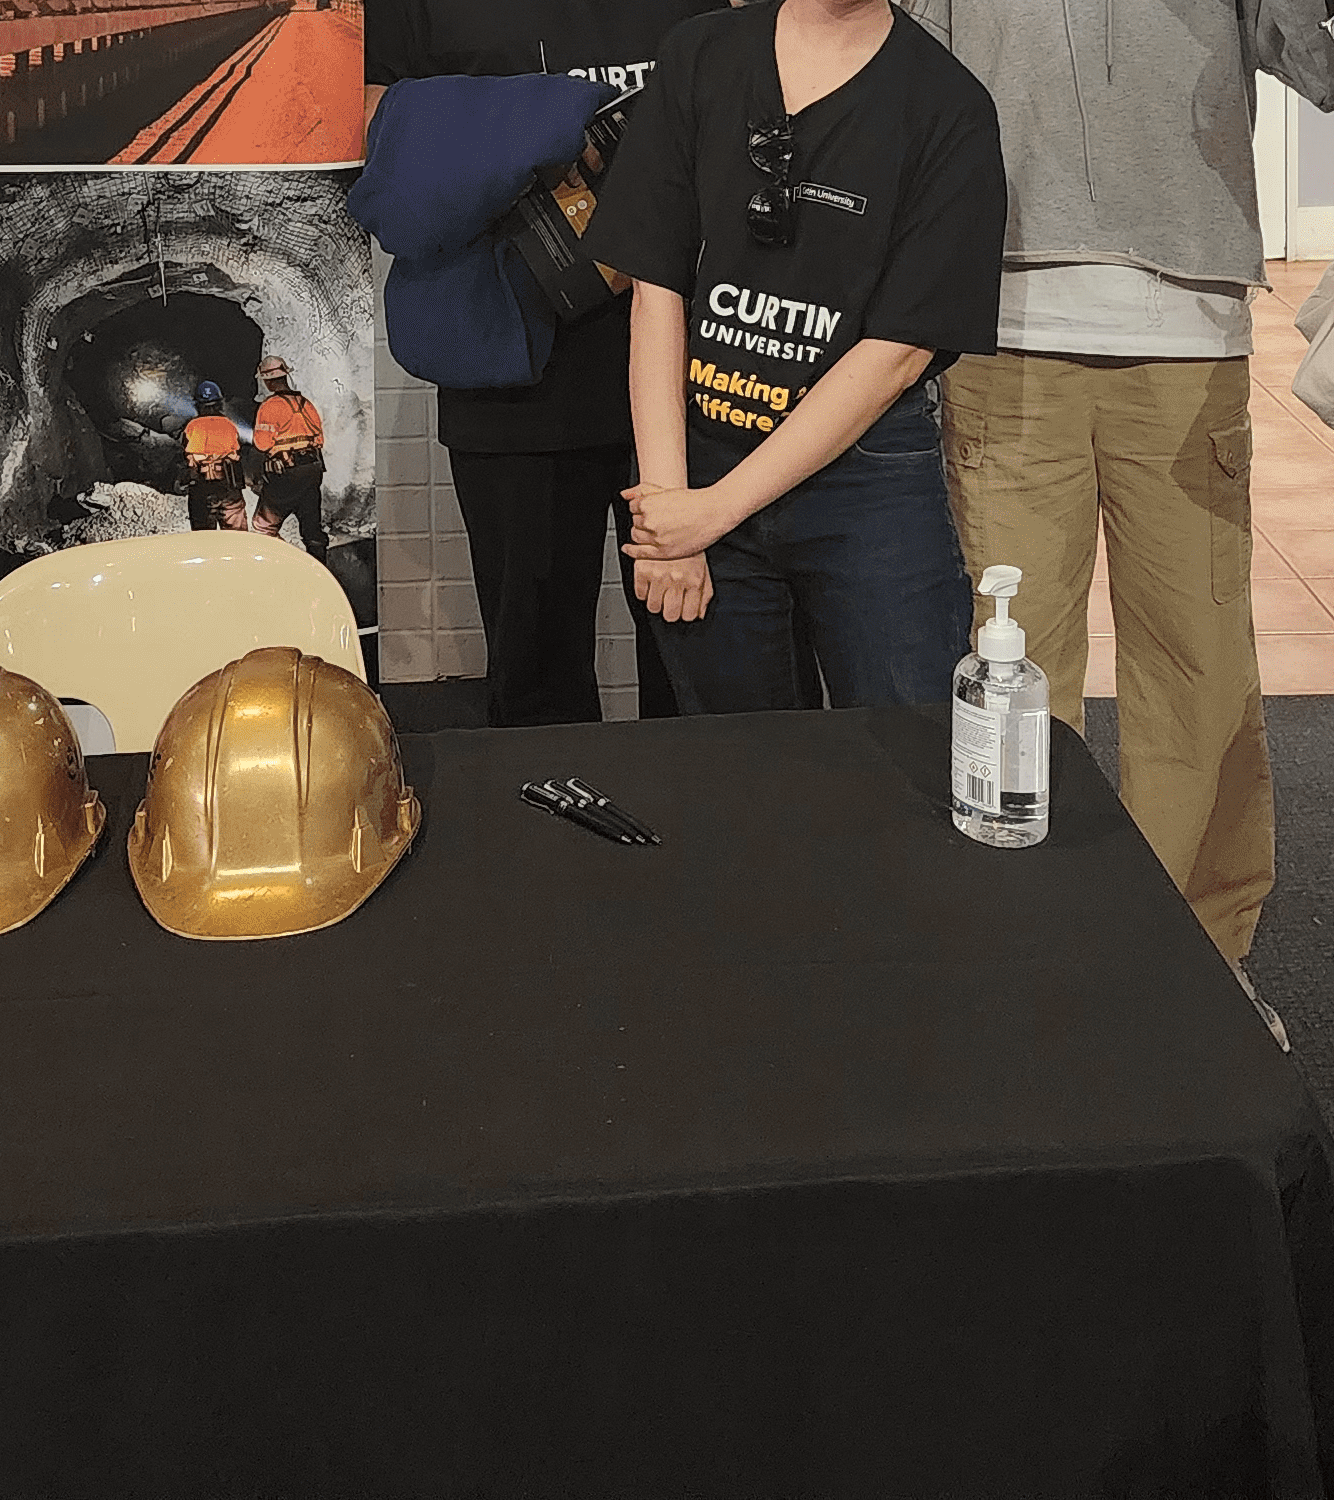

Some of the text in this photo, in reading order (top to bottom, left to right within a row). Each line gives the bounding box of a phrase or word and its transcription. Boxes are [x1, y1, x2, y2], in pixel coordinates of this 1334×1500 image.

[816, 188, 855, 208] University
[708, 283, 842, 343] CURTIN
[700, 319, 825, 363] UNIVERSIT
[689, 358, 790, 411] Making
